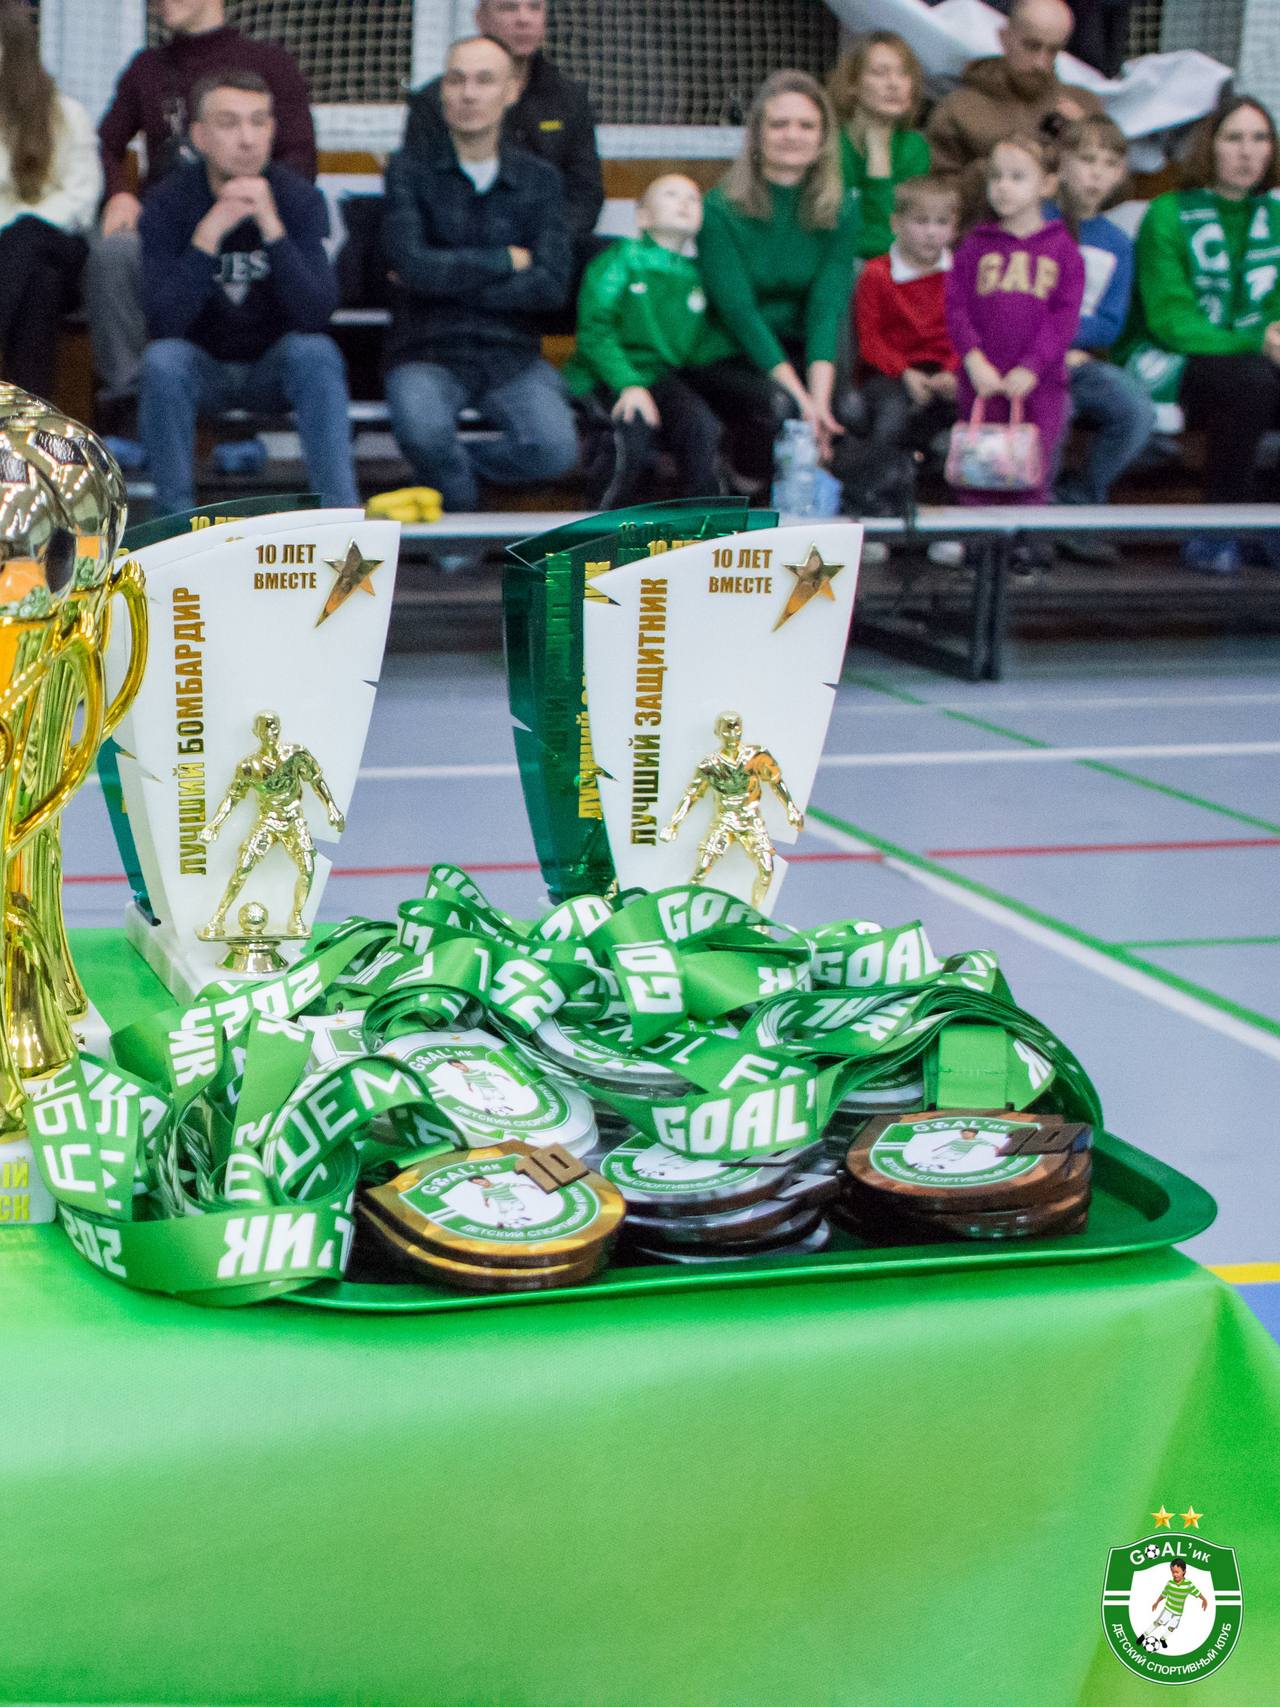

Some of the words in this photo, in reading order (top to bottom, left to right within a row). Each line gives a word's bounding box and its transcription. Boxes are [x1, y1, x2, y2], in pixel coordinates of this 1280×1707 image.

[976, 250, 1060, 299] GAP
[256, 544, 276, 565] 10
[281, 543, 317, 564] ЛЕТ
[712, 548, 733, 569] 10
[737, 549, 773, 569] ЛЕТ
[254, 571, 317, 590] ВМЕСТЕ
[709, 576, 773, 595] ВМЕСТЕ
[173, 586, 206, 755] БОМБАРДИР
[634, 577, 669, 727] ЗАЩИТНИК
[628, 734, 661, 846] ЛУЧШИЙ
[173, 762, 207, 876] ЛУЧШИЙ
